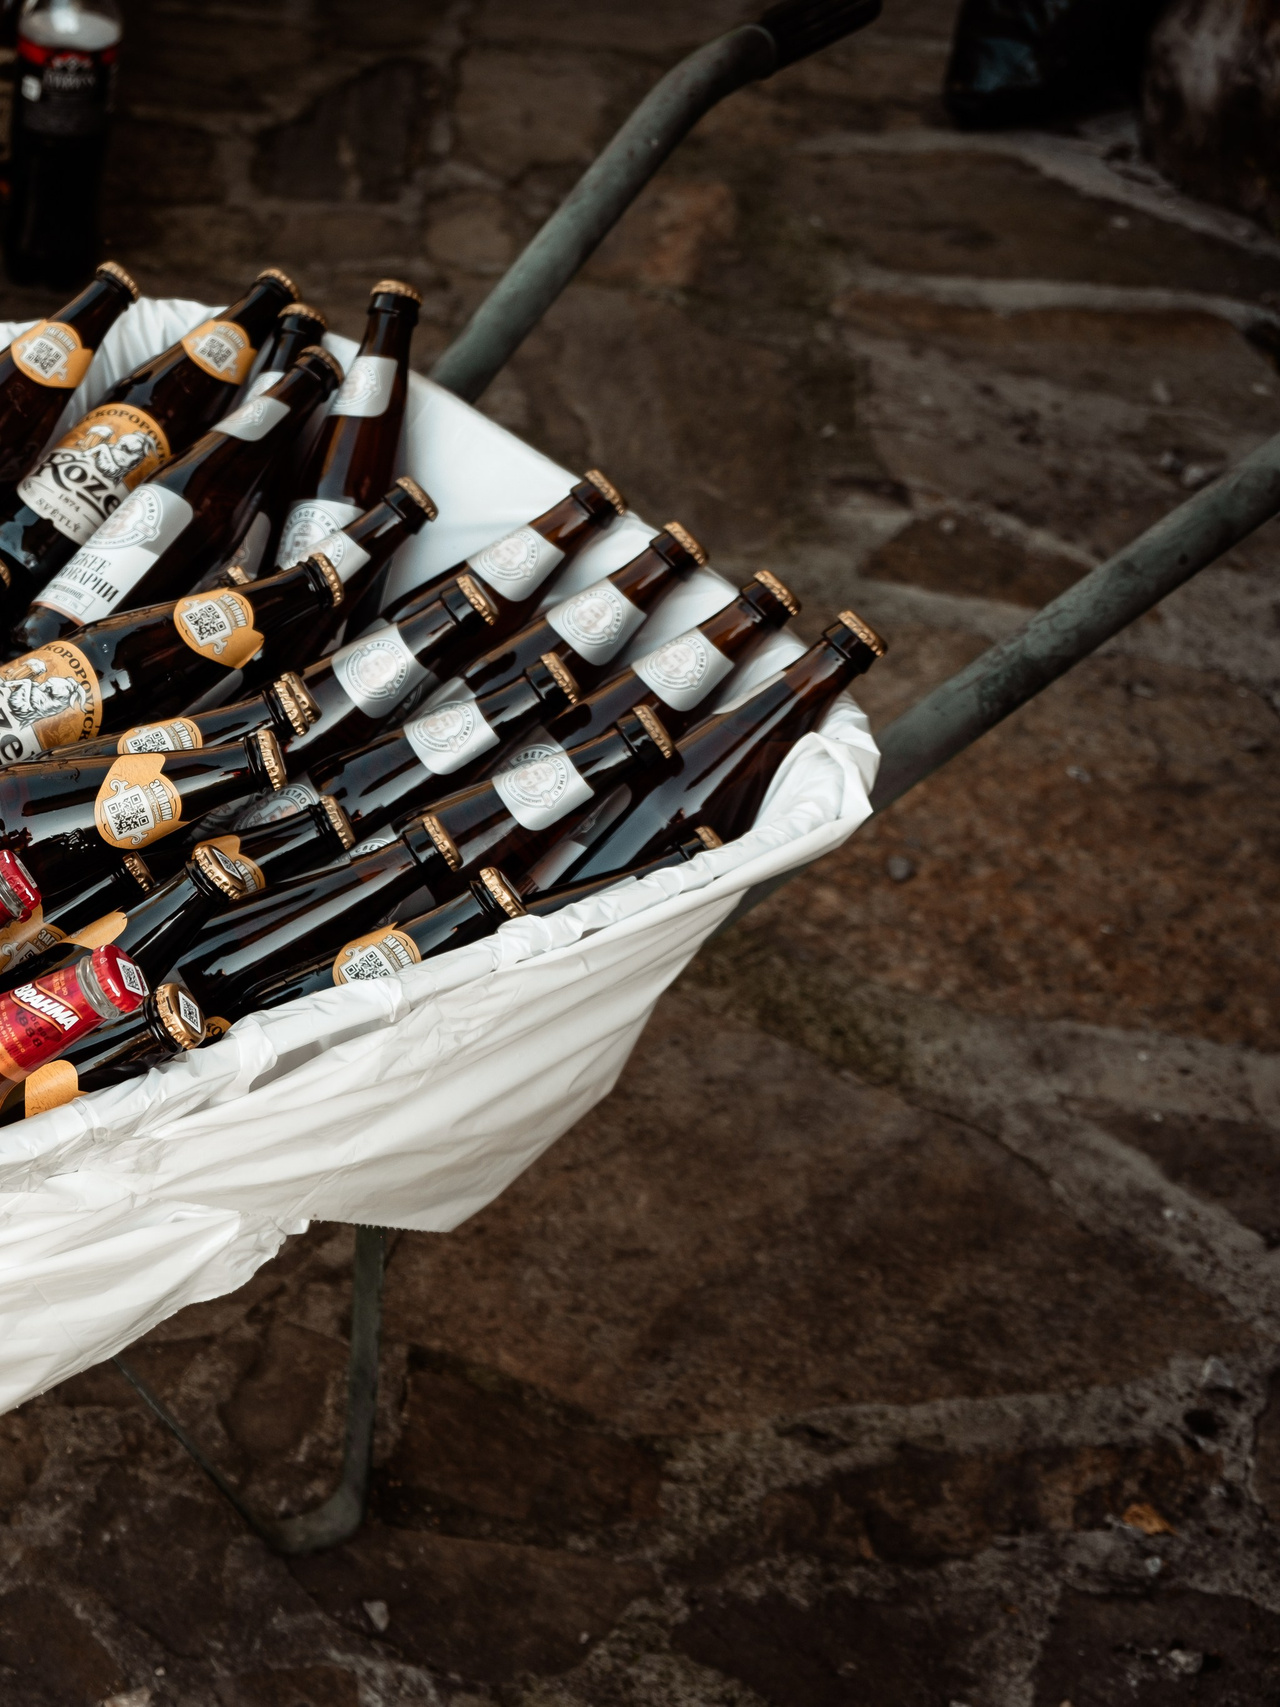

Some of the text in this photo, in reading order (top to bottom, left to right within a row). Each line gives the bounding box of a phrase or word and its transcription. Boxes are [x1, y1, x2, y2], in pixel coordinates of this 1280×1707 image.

[32, 451, 123, 516] Koze
[149, 779, 174, 821] ЗАГЛЯНИ
[234, 859, 258, 891] ЗАГЛЯН
[14, 983, 80, 1031] BRAHMA
[6, 1022, 26, 1053] JANEIRO
